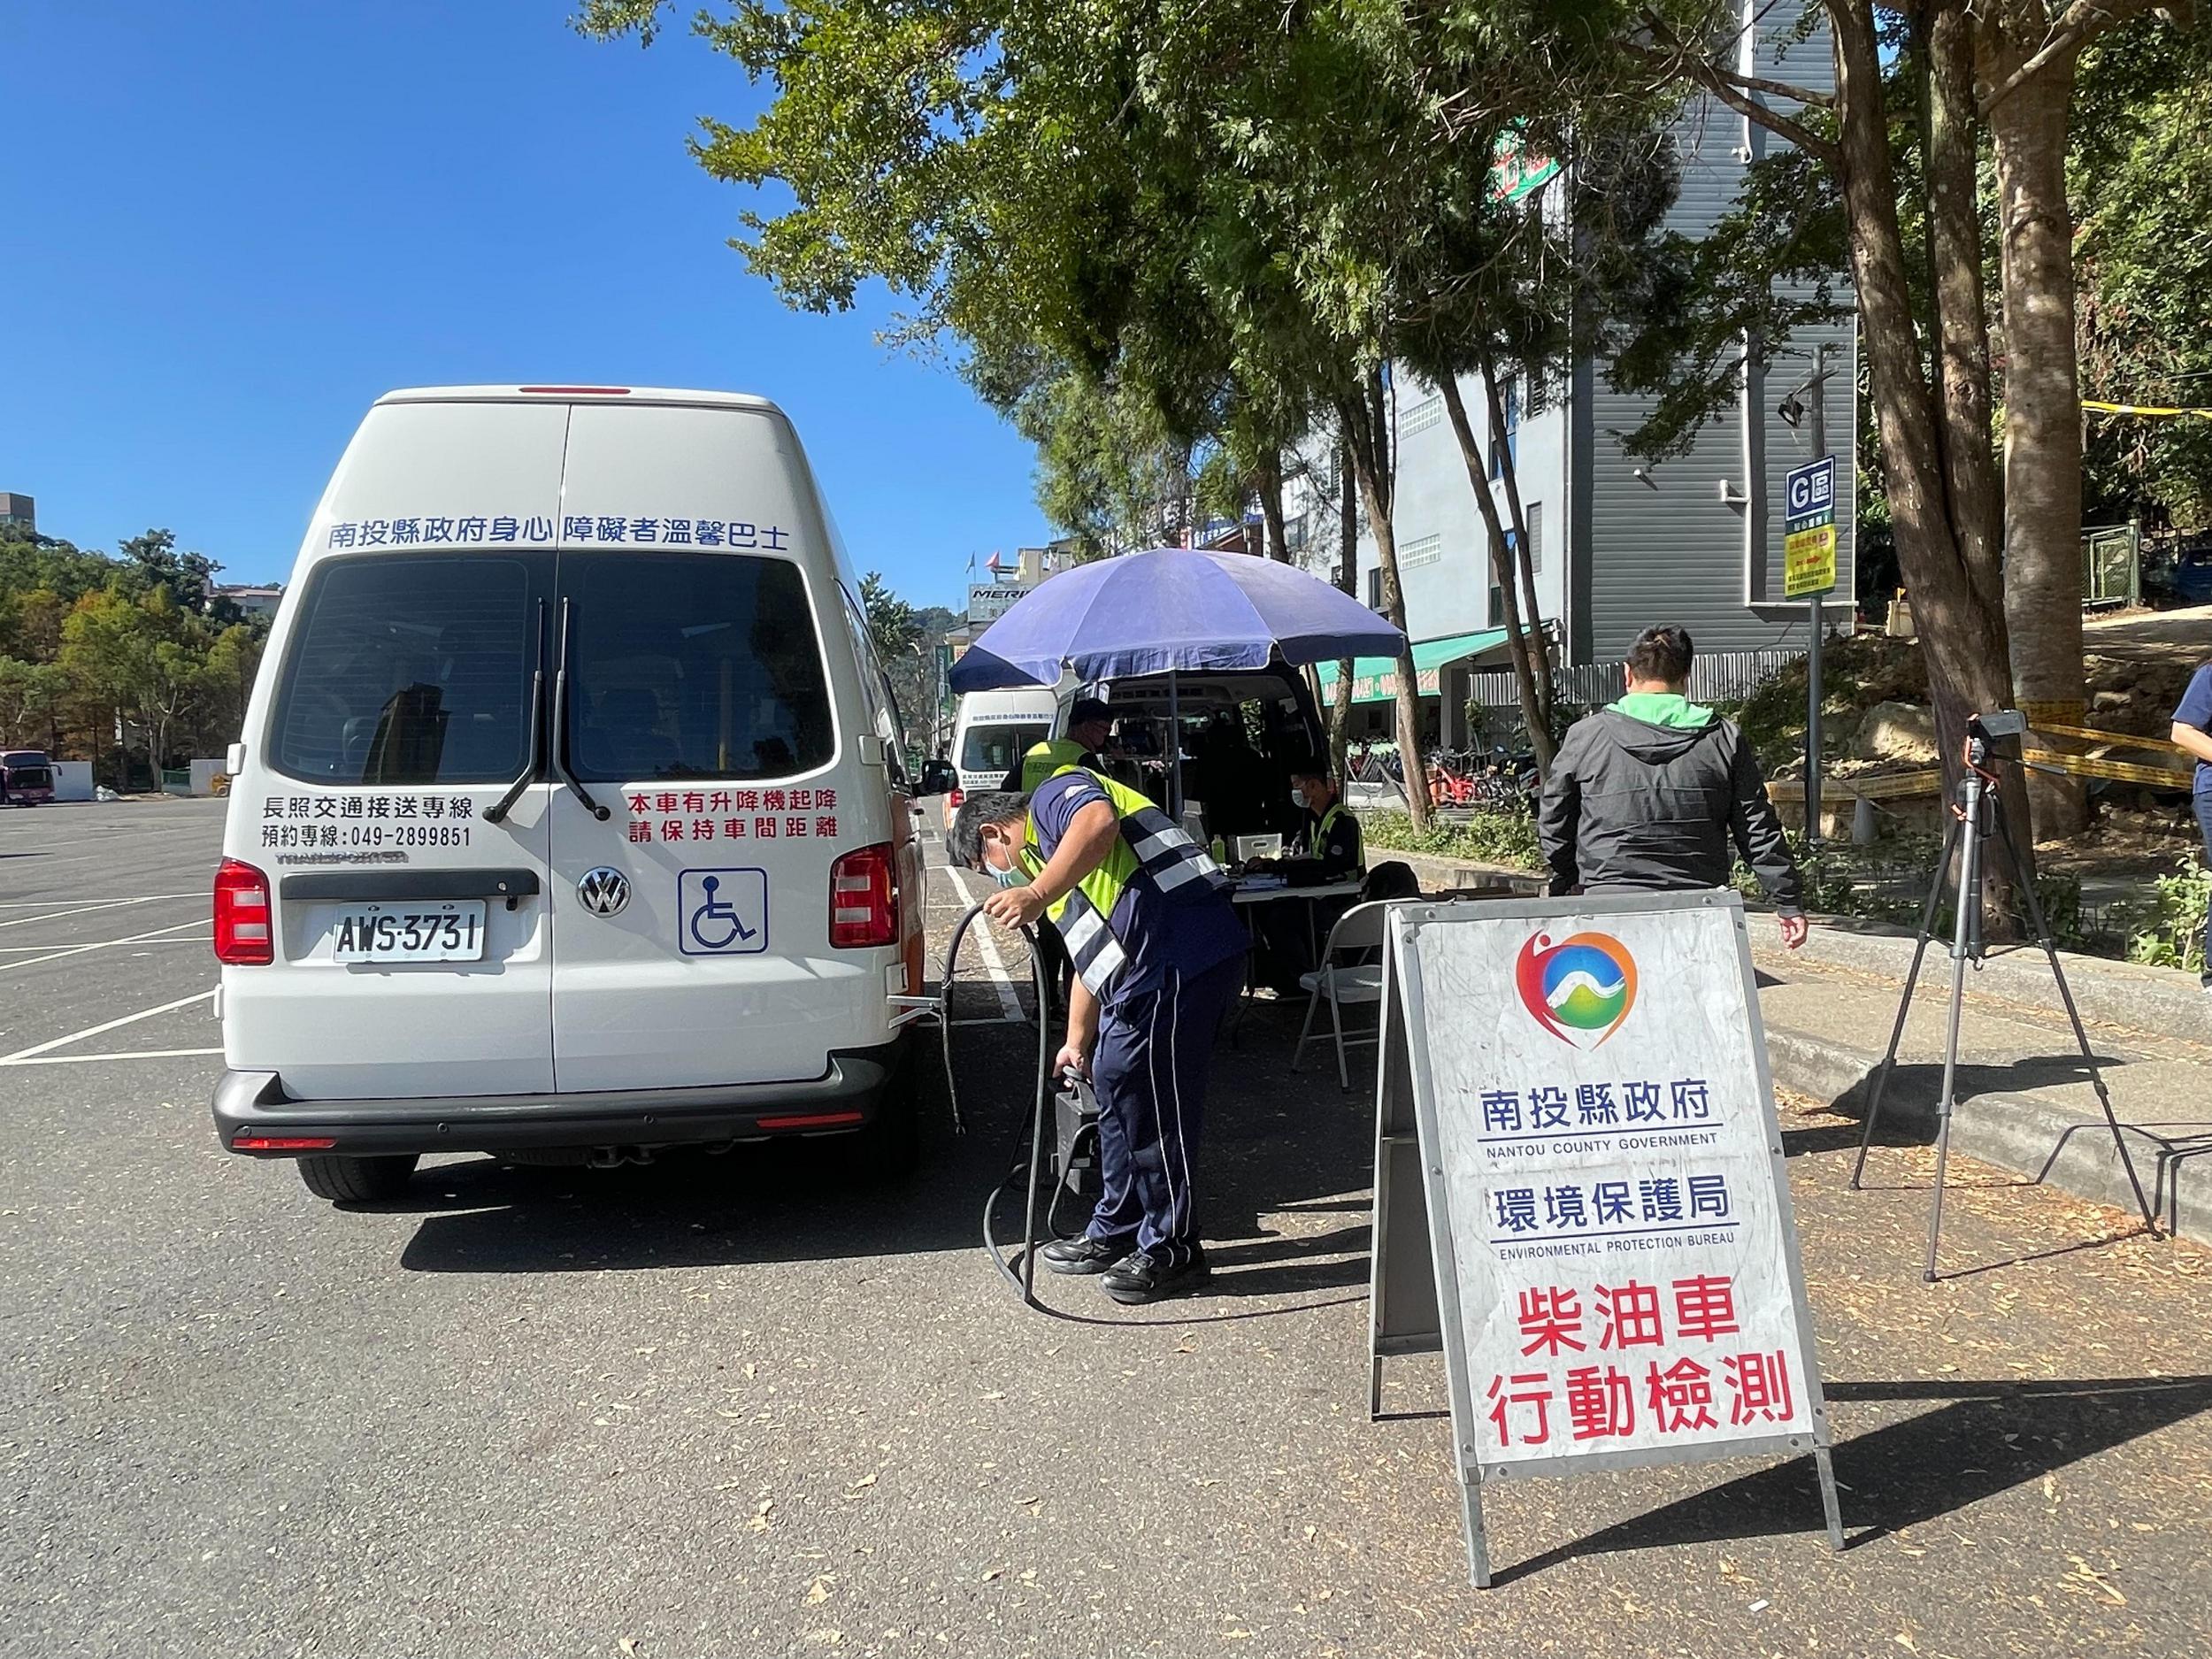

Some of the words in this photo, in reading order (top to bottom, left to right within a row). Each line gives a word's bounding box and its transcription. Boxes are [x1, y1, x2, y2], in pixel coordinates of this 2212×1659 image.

[1791, 468, 1831, 509] G區
[262, 795, 474, 819] 長照交通接送專線
[627, 789, 838, 815] 本車有升降機起降
[628, 816, 839, 843] 請保持車間距離
[1479, 1077, 1711, 1132] 南投縣政府
[1486, 1144, 1546, 1158] NANTOU
[1553, 1140, 1611, 1155] COUNTY
[1618, 1133, 1718, 1150] GOVERNMENT
[1494, 1174, 1730, 1233] 環境保護局
[1500, 1241, 1602, 1260] ENVIRONMENTAL
[1607, 1235, 1682, 1253] PROTECTION
[1687, 1231, 1735, 1247] BUREAU
[1517, 1274, 1740, 1356] 柴油車
[1486, 1349, 1794, 1447] 行動檢測
